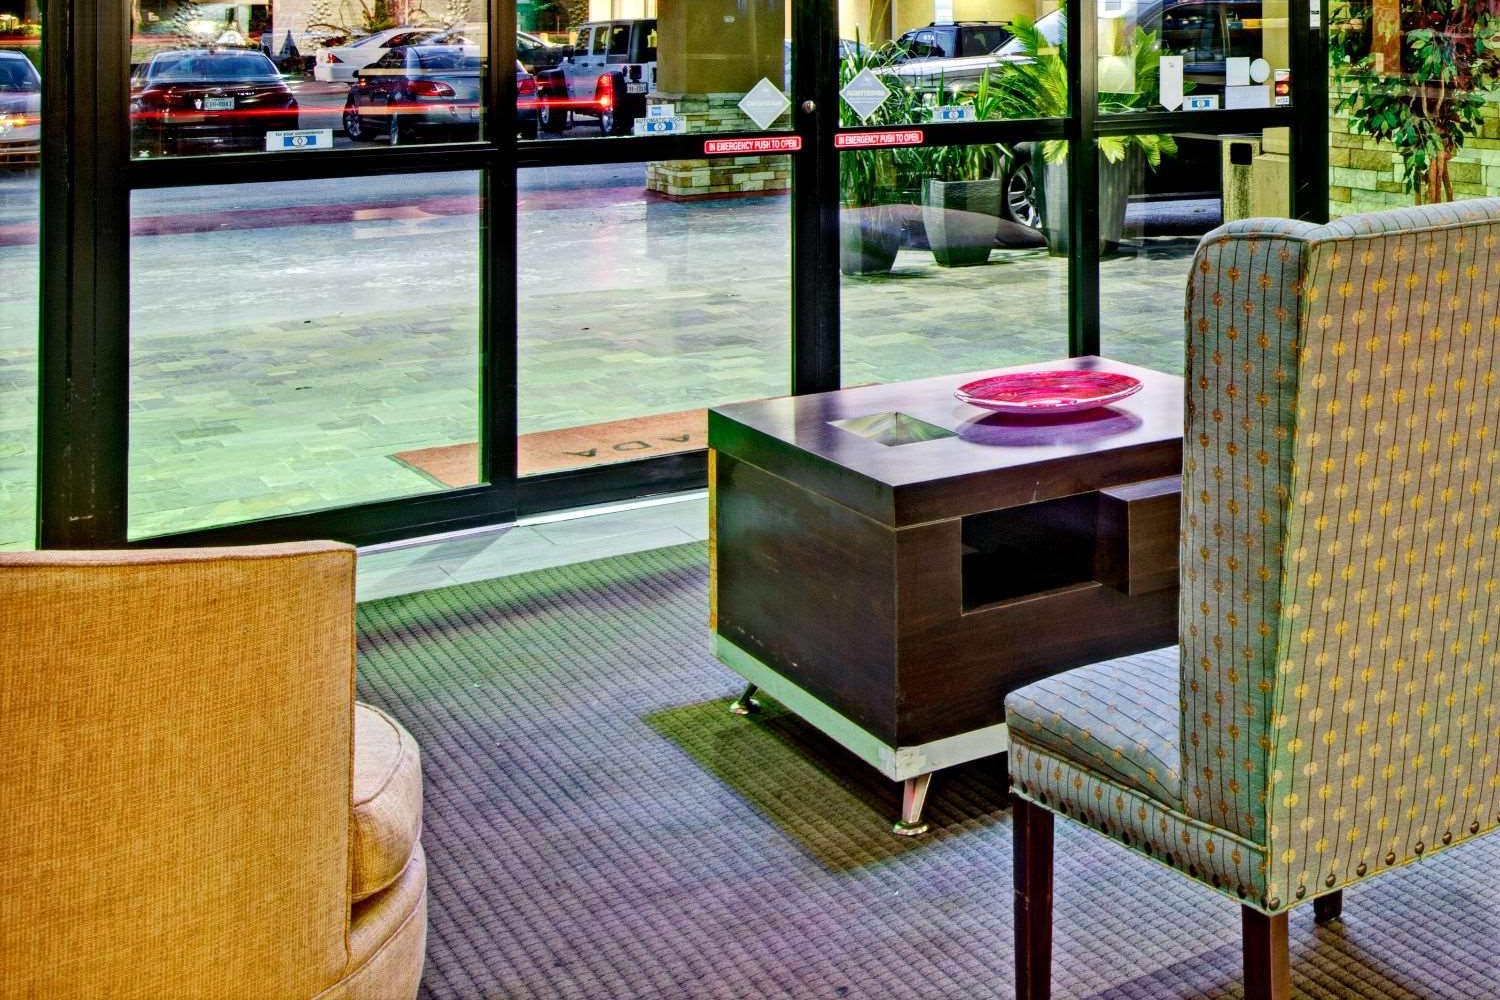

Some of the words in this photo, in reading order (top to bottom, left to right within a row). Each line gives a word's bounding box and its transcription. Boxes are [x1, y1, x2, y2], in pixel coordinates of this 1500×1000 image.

[708, 142, 715, 151] IN
[717, 141, 754, 151] EMERGENCY
[755, 140, 770, 150] PUSH
[771, 140, 780, 149] TO
[781, 139, 797, 149] OPEN
[838, 136, 844, 145] IN
[845, 135, 879, 145] EMERGENCY
[880, 134, 893, 144] PUSH
[895, 134, 903, 143] TO
[904, 133, 919, 142] OPEN
